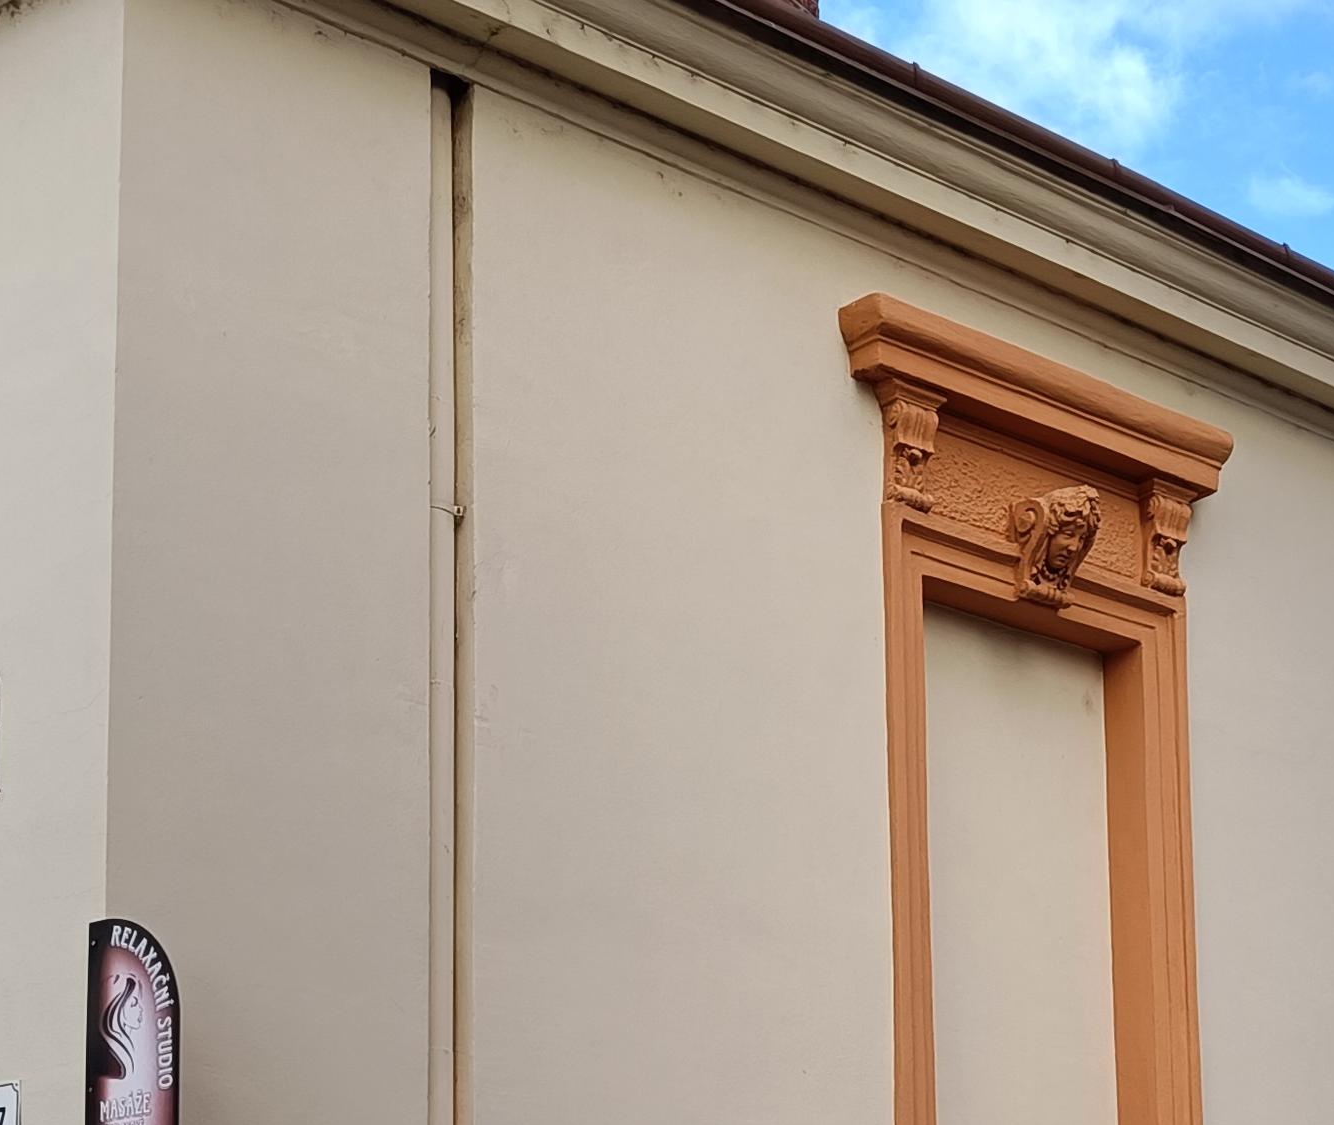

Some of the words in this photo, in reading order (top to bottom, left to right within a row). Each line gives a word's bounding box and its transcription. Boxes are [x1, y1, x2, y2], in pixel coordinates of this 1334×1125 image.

[110, 925, 174, 1012] RELAXAČNÍ
[157, 1016, 173, 1089] STUDIO
[99, 1090, 151, 1123] MASÁŽE
